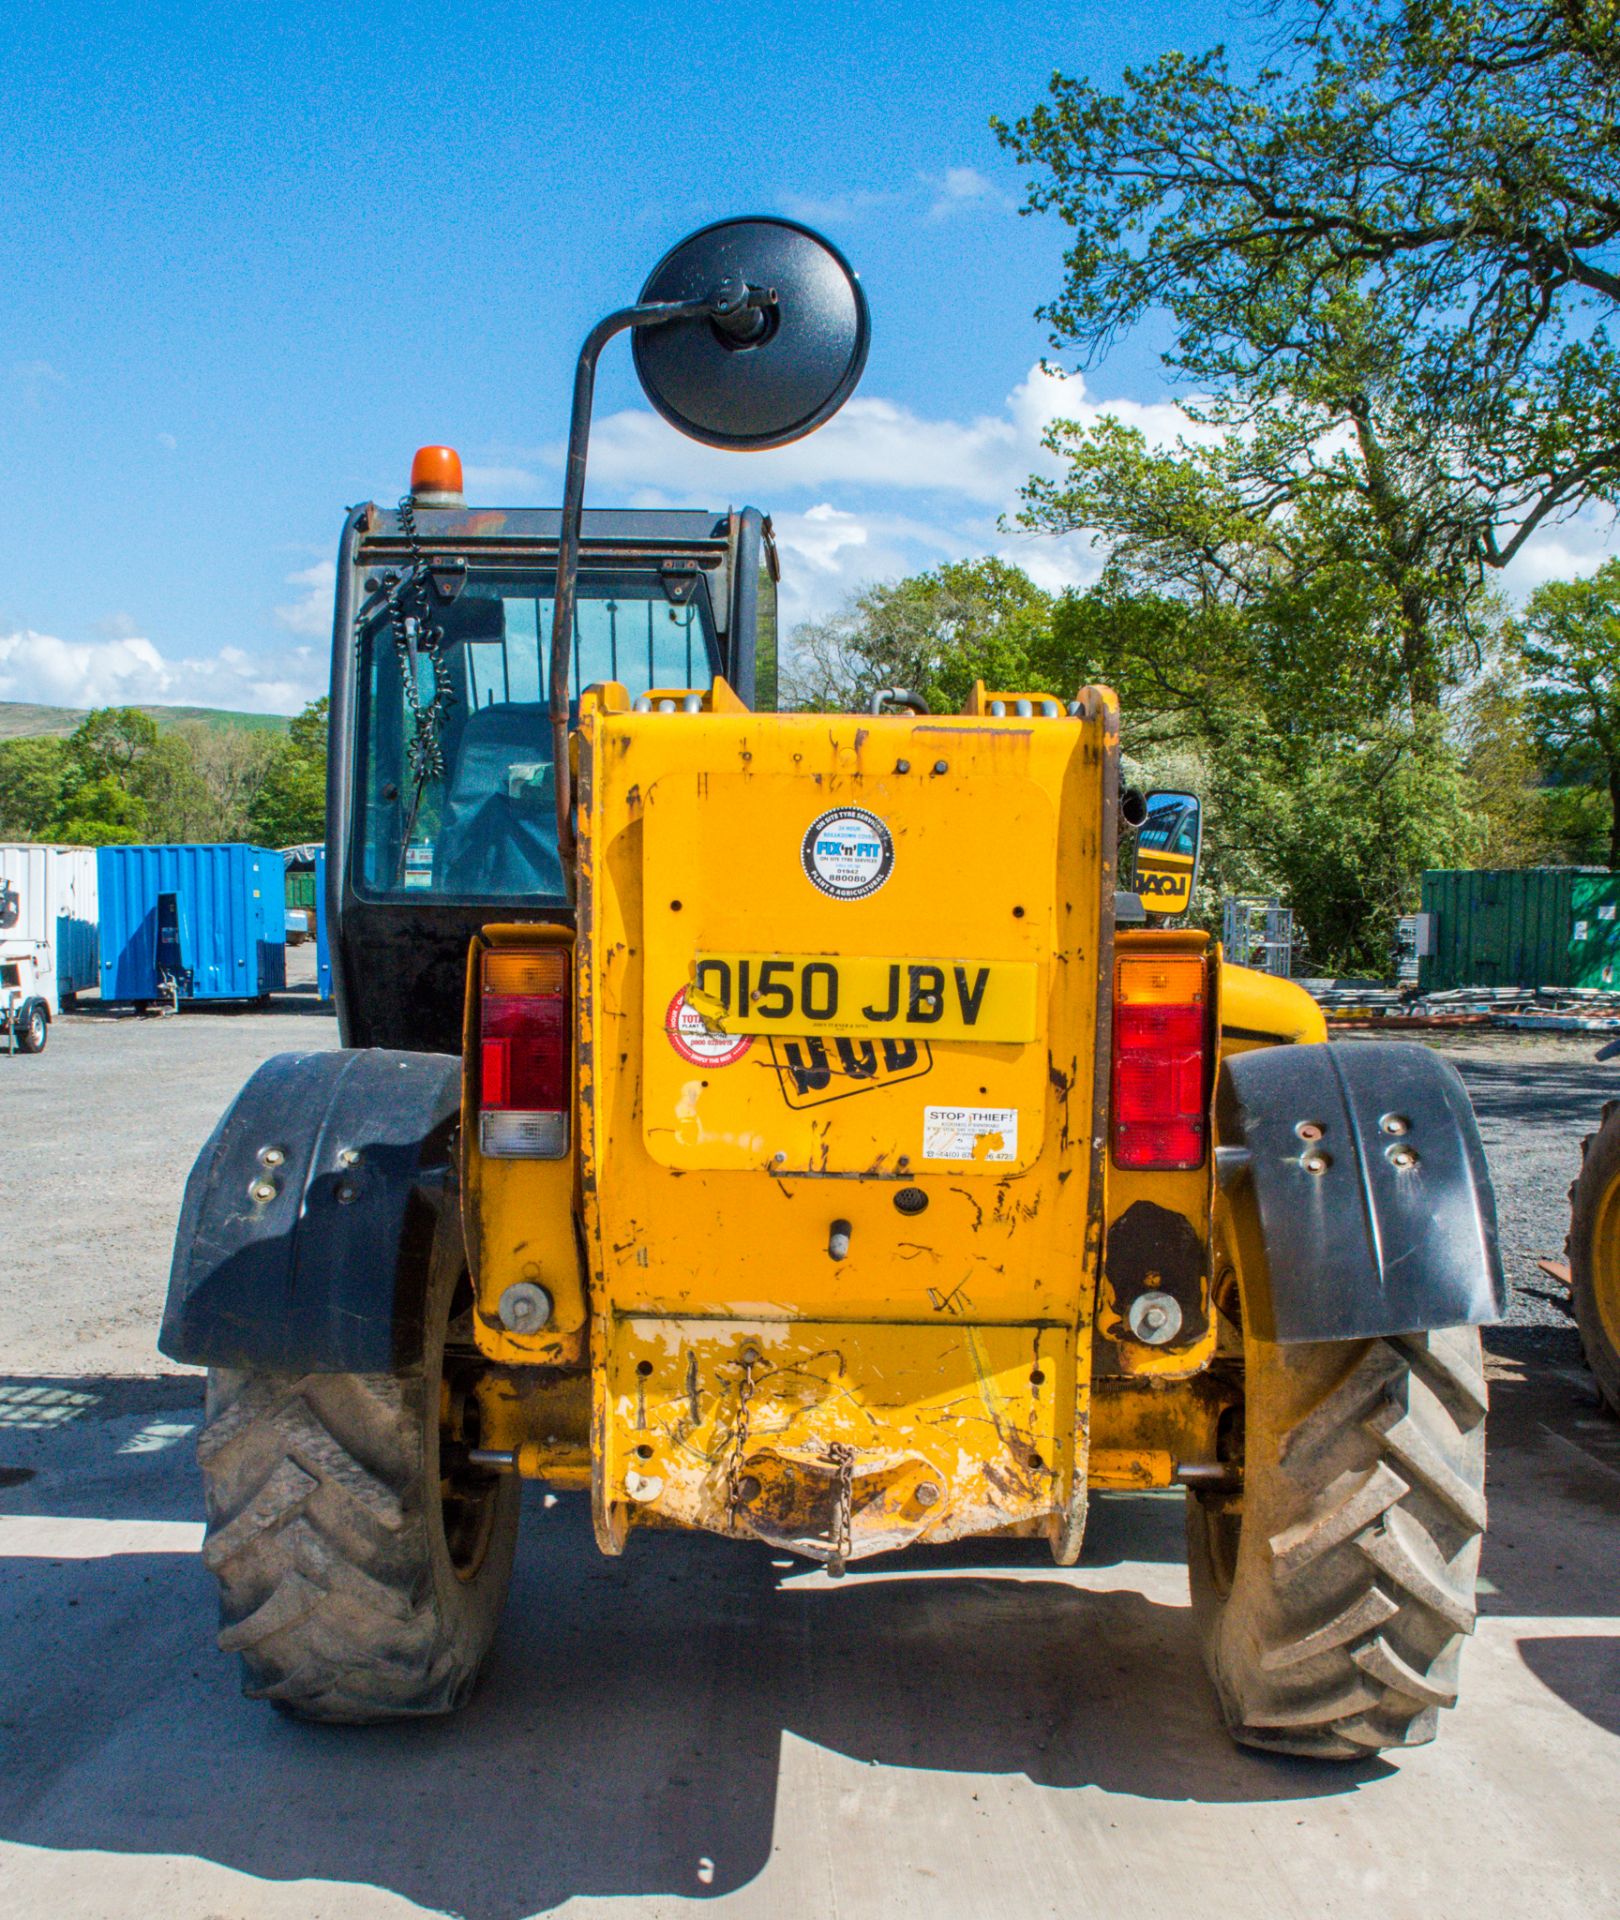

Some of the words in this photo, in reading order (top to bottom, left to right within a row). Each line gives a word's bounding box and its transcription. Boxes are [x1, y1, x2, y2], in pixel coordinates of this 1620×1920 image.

[839, 811, 856, 819] TYRE
[811, 871, 829, 889] PLANT
[836, 874, 884, 895] AGRICULTURAL
[862, 964, 990, 1026] JBV
[929, 1111, 966, 1121] STOP
[971, 1112, 1013, 1122] THIEF!
